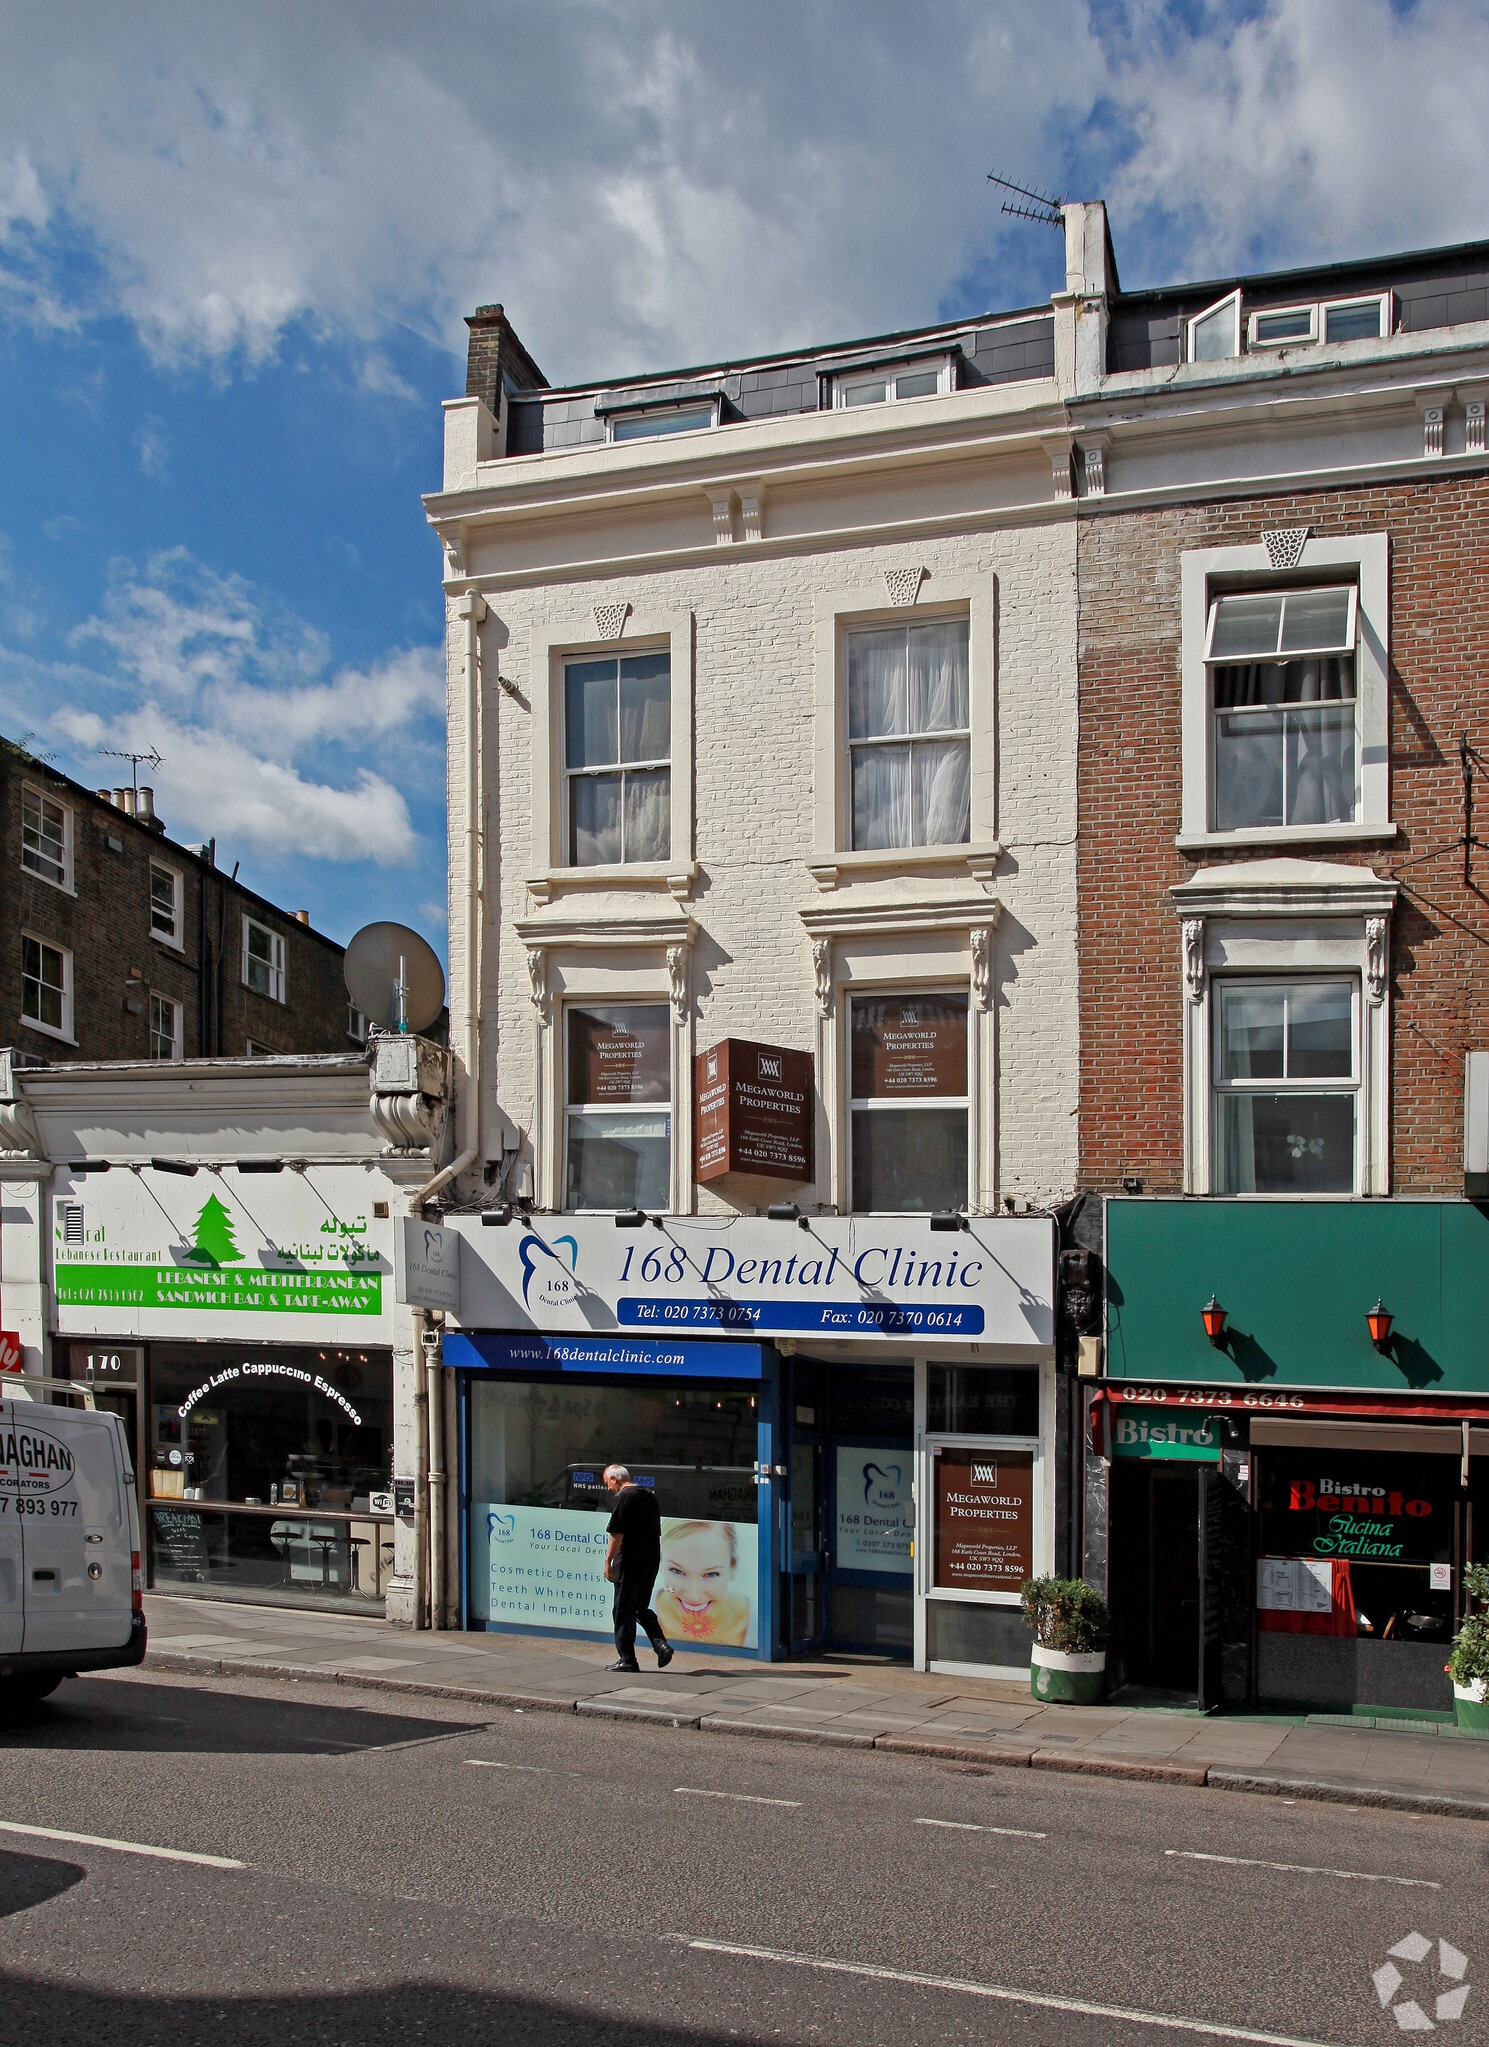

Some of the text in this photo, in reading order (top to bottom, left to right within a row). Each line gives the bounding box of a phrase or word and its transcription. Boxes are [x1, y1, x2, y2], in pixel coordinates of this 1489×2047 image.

[883, 1031, 937, 1040] MEGAWORLD
[597, 1041, 645, 1050] MEGAWORLD
[886, 1041, 934, 1050] PROPERTIES
[600, 1051, 642, 1059] PROPERTIES
[735, 1082, 805, 1102] MEGAWORLD
[739, 1095, 801, 1114] PROPERTIES
[738, 1147, 806, 1163] +44 020 7373 8596
[56, 1247, 162, 1262] Lebanese Restaurant
[409, 1261, 457, 1281] 168 Dental Clinic
[617, 1245, 983, 1287] 168 Dental Clinic
[157, 1271, 378, 1290] LEBANESE & MEDITERRANEAN
[546, 1280, 569, 1292] 168
[157, 1290, 371, 1309] SANDWICH BAR & TAKE-AWAY
[538, 1293, 559, 1307] Dental
[637, 1304, 761, 1321] Tel: 020 7373 0754
[820, 1309, 963, 1327] Fax: 020 7370 0614
[86, 1354, 121, 1371] 170
[509, 1346, 685, 1364] www.168dentalclinic.com
[178, 1362, 362, 1426] Coffee Latte Cappuccino Espresso
[1122, 1386, 1304, 1408] 020 7373 6646
[1116, 1418, 1214, 1446] Bistro
[0, 1478, 50, 1489] CORATORS
[574, 1472, 594, 1481] NHS
[879, 1490, 895, 1500] 168
[1319, 1478, 1386, 1497] Bistro
[946, 1492, 1022, 1506] MEGAWORLD
[1289, 1480, 1433, 1517] Benito
[16, 1498, 45, 1515] 893
[51, 1500, 78, 1517] 977
[950, 1506, 1018, 1520] PROPERTIES
[840, 1514, 860, 1525] 168
[864, 1515, 899, 1528] Dental
[1329, 1513, 1394, 1536] Cucina
[499, 1529, 511, 1537] 168
[530, 1528, 551, 1540] 168
[555, 1530, 590, 1544] Dental
[530, 1542, 550, 1550] Your
[555, 1544, 581, 1553] Local
[1313, 1533, 1404, 1557] Italiana
[491, 1563, 552, 1578] Cosmetic
[949, 1562, 1024, 1574] +44 020 7373 8596
[491, 1582, 606, 1604] Teeth Whitening
[491, 1597, 604, 1618] Dental Implants
